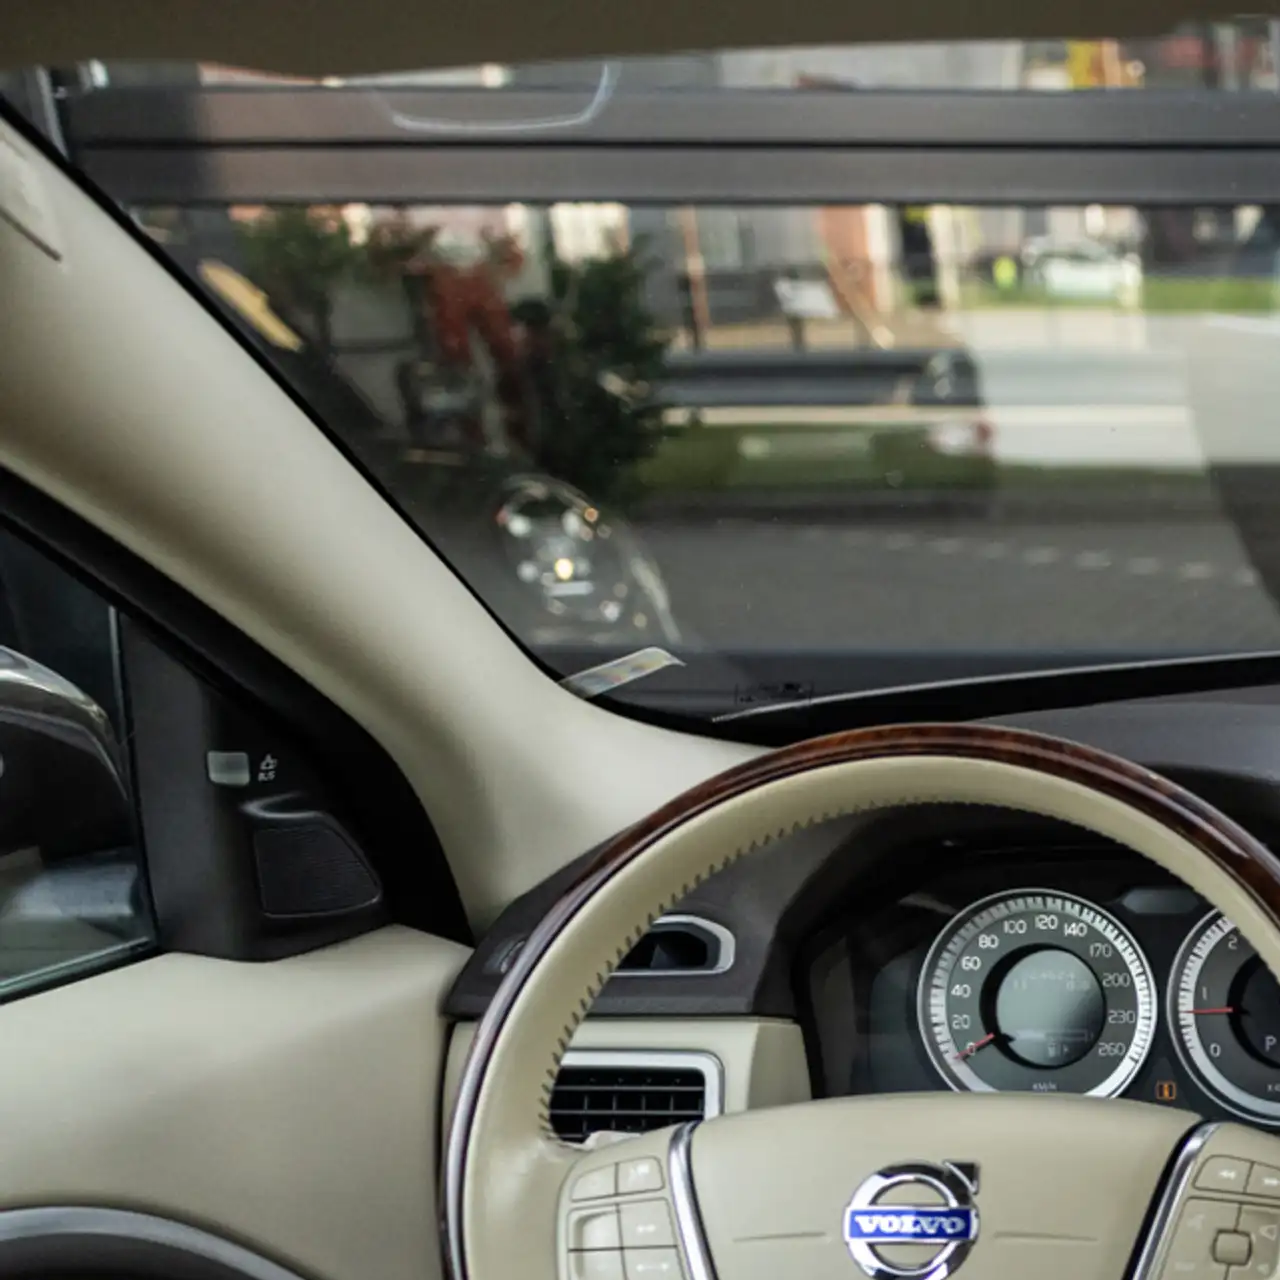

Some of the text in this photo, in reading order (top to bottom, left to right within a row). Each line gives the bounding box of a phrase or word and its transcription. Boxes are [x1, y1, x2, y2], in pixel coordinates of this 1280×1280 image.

[1003, 920, 1027, 934] 100
[1035, 914, 1058, 929] 120
[1064, 922, 1087, 937] 140
[978, 935, 999, 948] 80
[1228, 935, 1237, 950] 2
[1089, 942, 1113, 958] 170
[961, 956, 981, 970] 60
[1102, 972, 1130, 987] 200
[951, 984, 971, 998] 40
[952, 1015, 971, 1029] 20
[1108, 1010, 1136, 1024] 230
[1098, 1042, 1125, 1056] 260
[1210, 1043, 1221, 1058] 0
[1265, 1036, 1277, 1051] P
[855, 1214, 965, 1234] VOLVO
